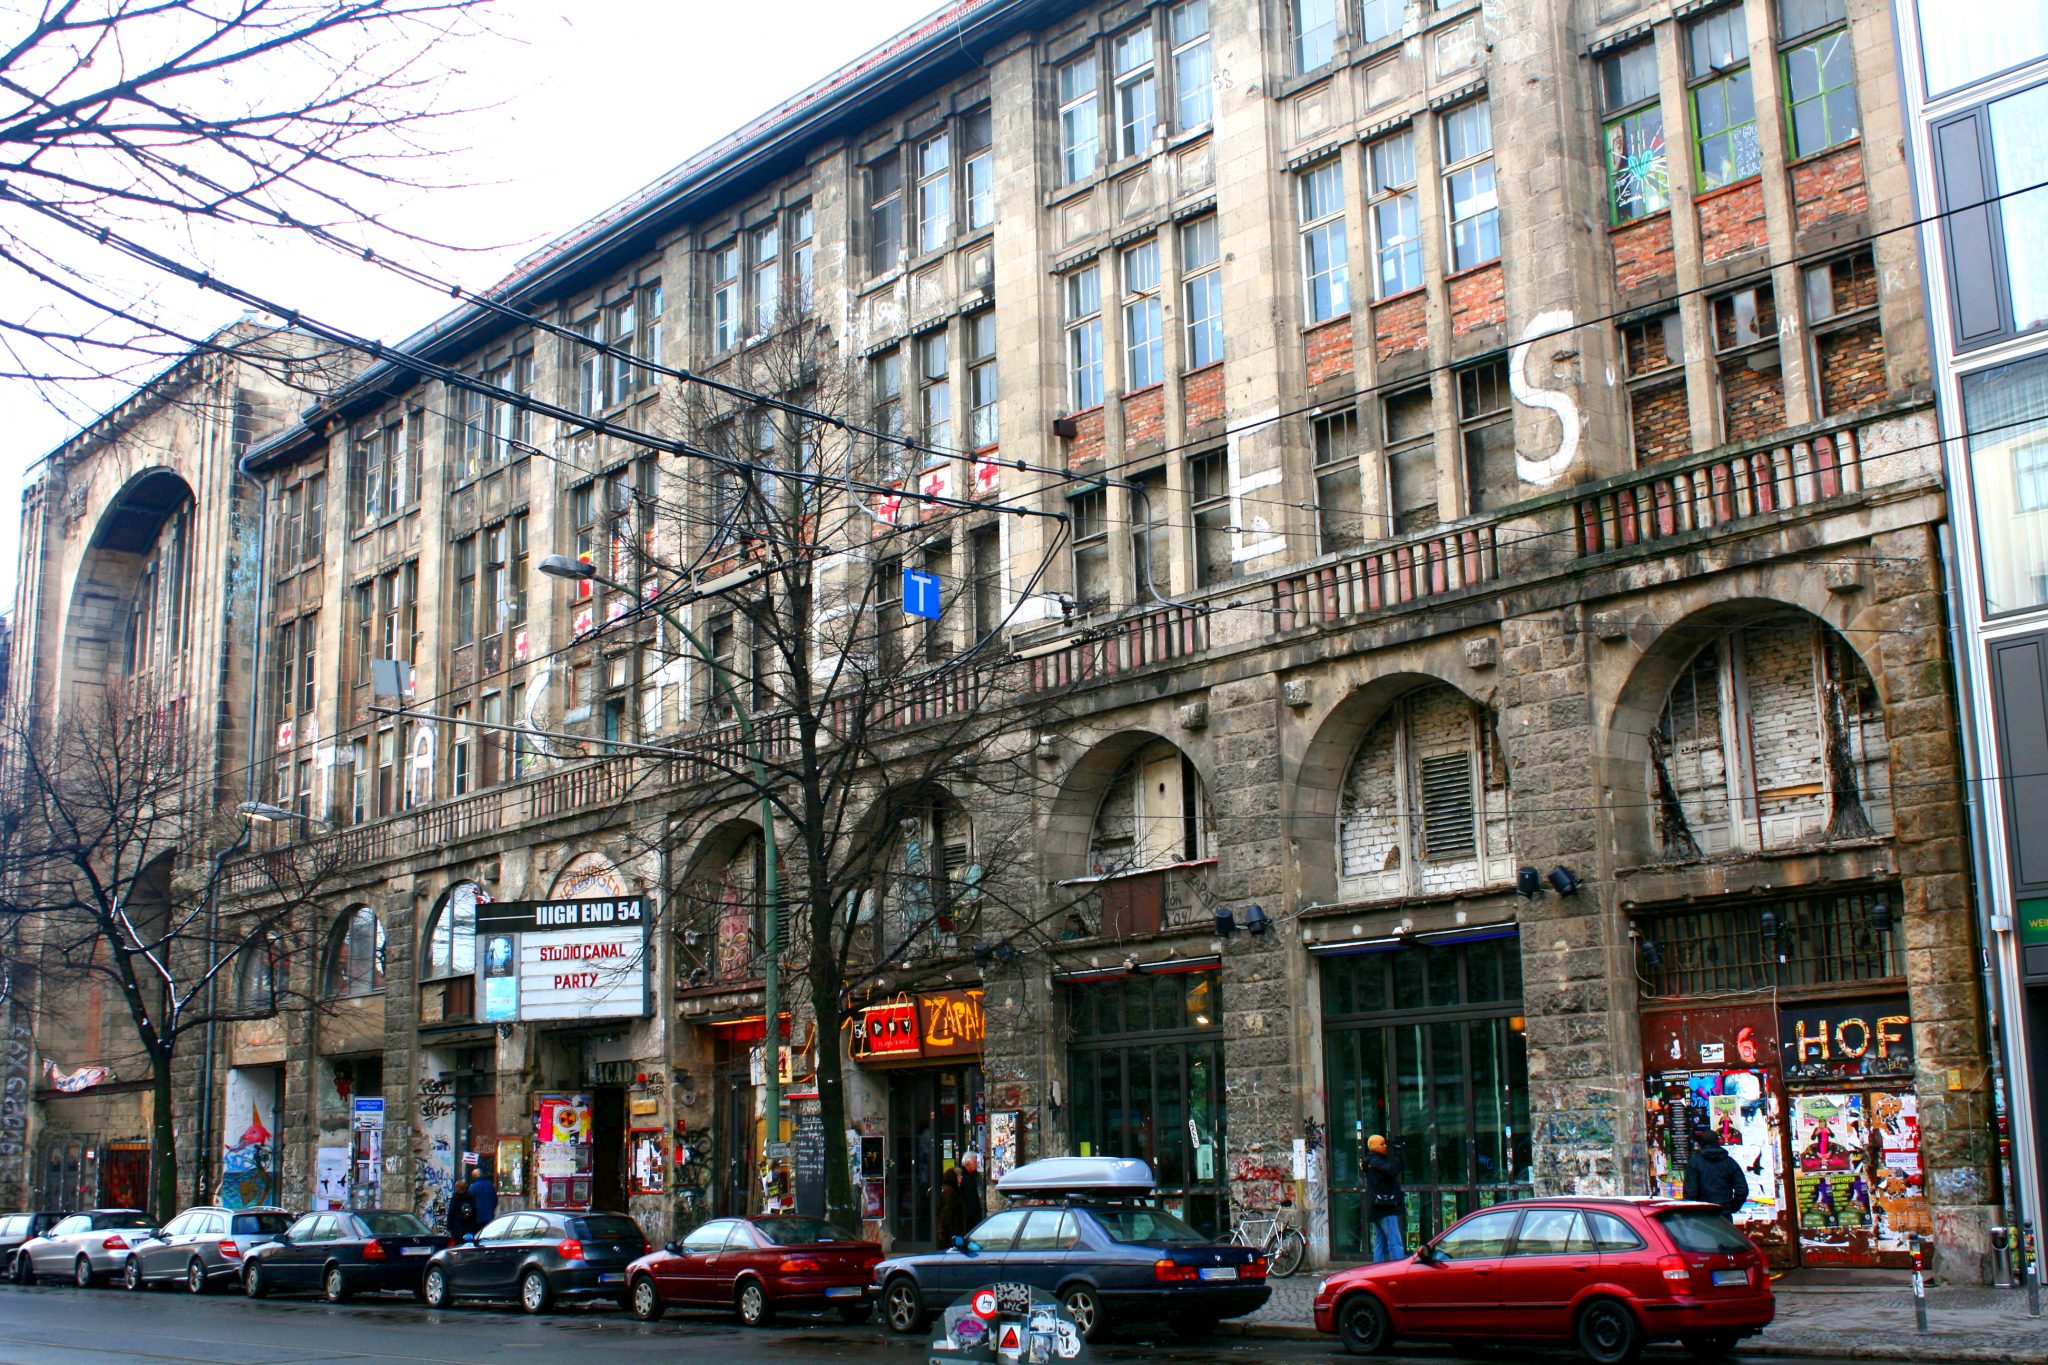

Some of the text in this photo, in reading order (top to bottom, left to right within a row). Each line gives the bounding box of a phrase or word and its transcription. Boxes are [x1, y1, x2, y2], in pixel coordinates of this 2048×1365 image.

[910, 574, 932, 612] T
[581, 902, 614, 923] END
[618, 901, 641, 921] 54
[540, 943, 626, 961] STUDIO CANAL
[554, 973, 599, 990] PARTY
[1796, 1015, 1911, 1064] HOF
